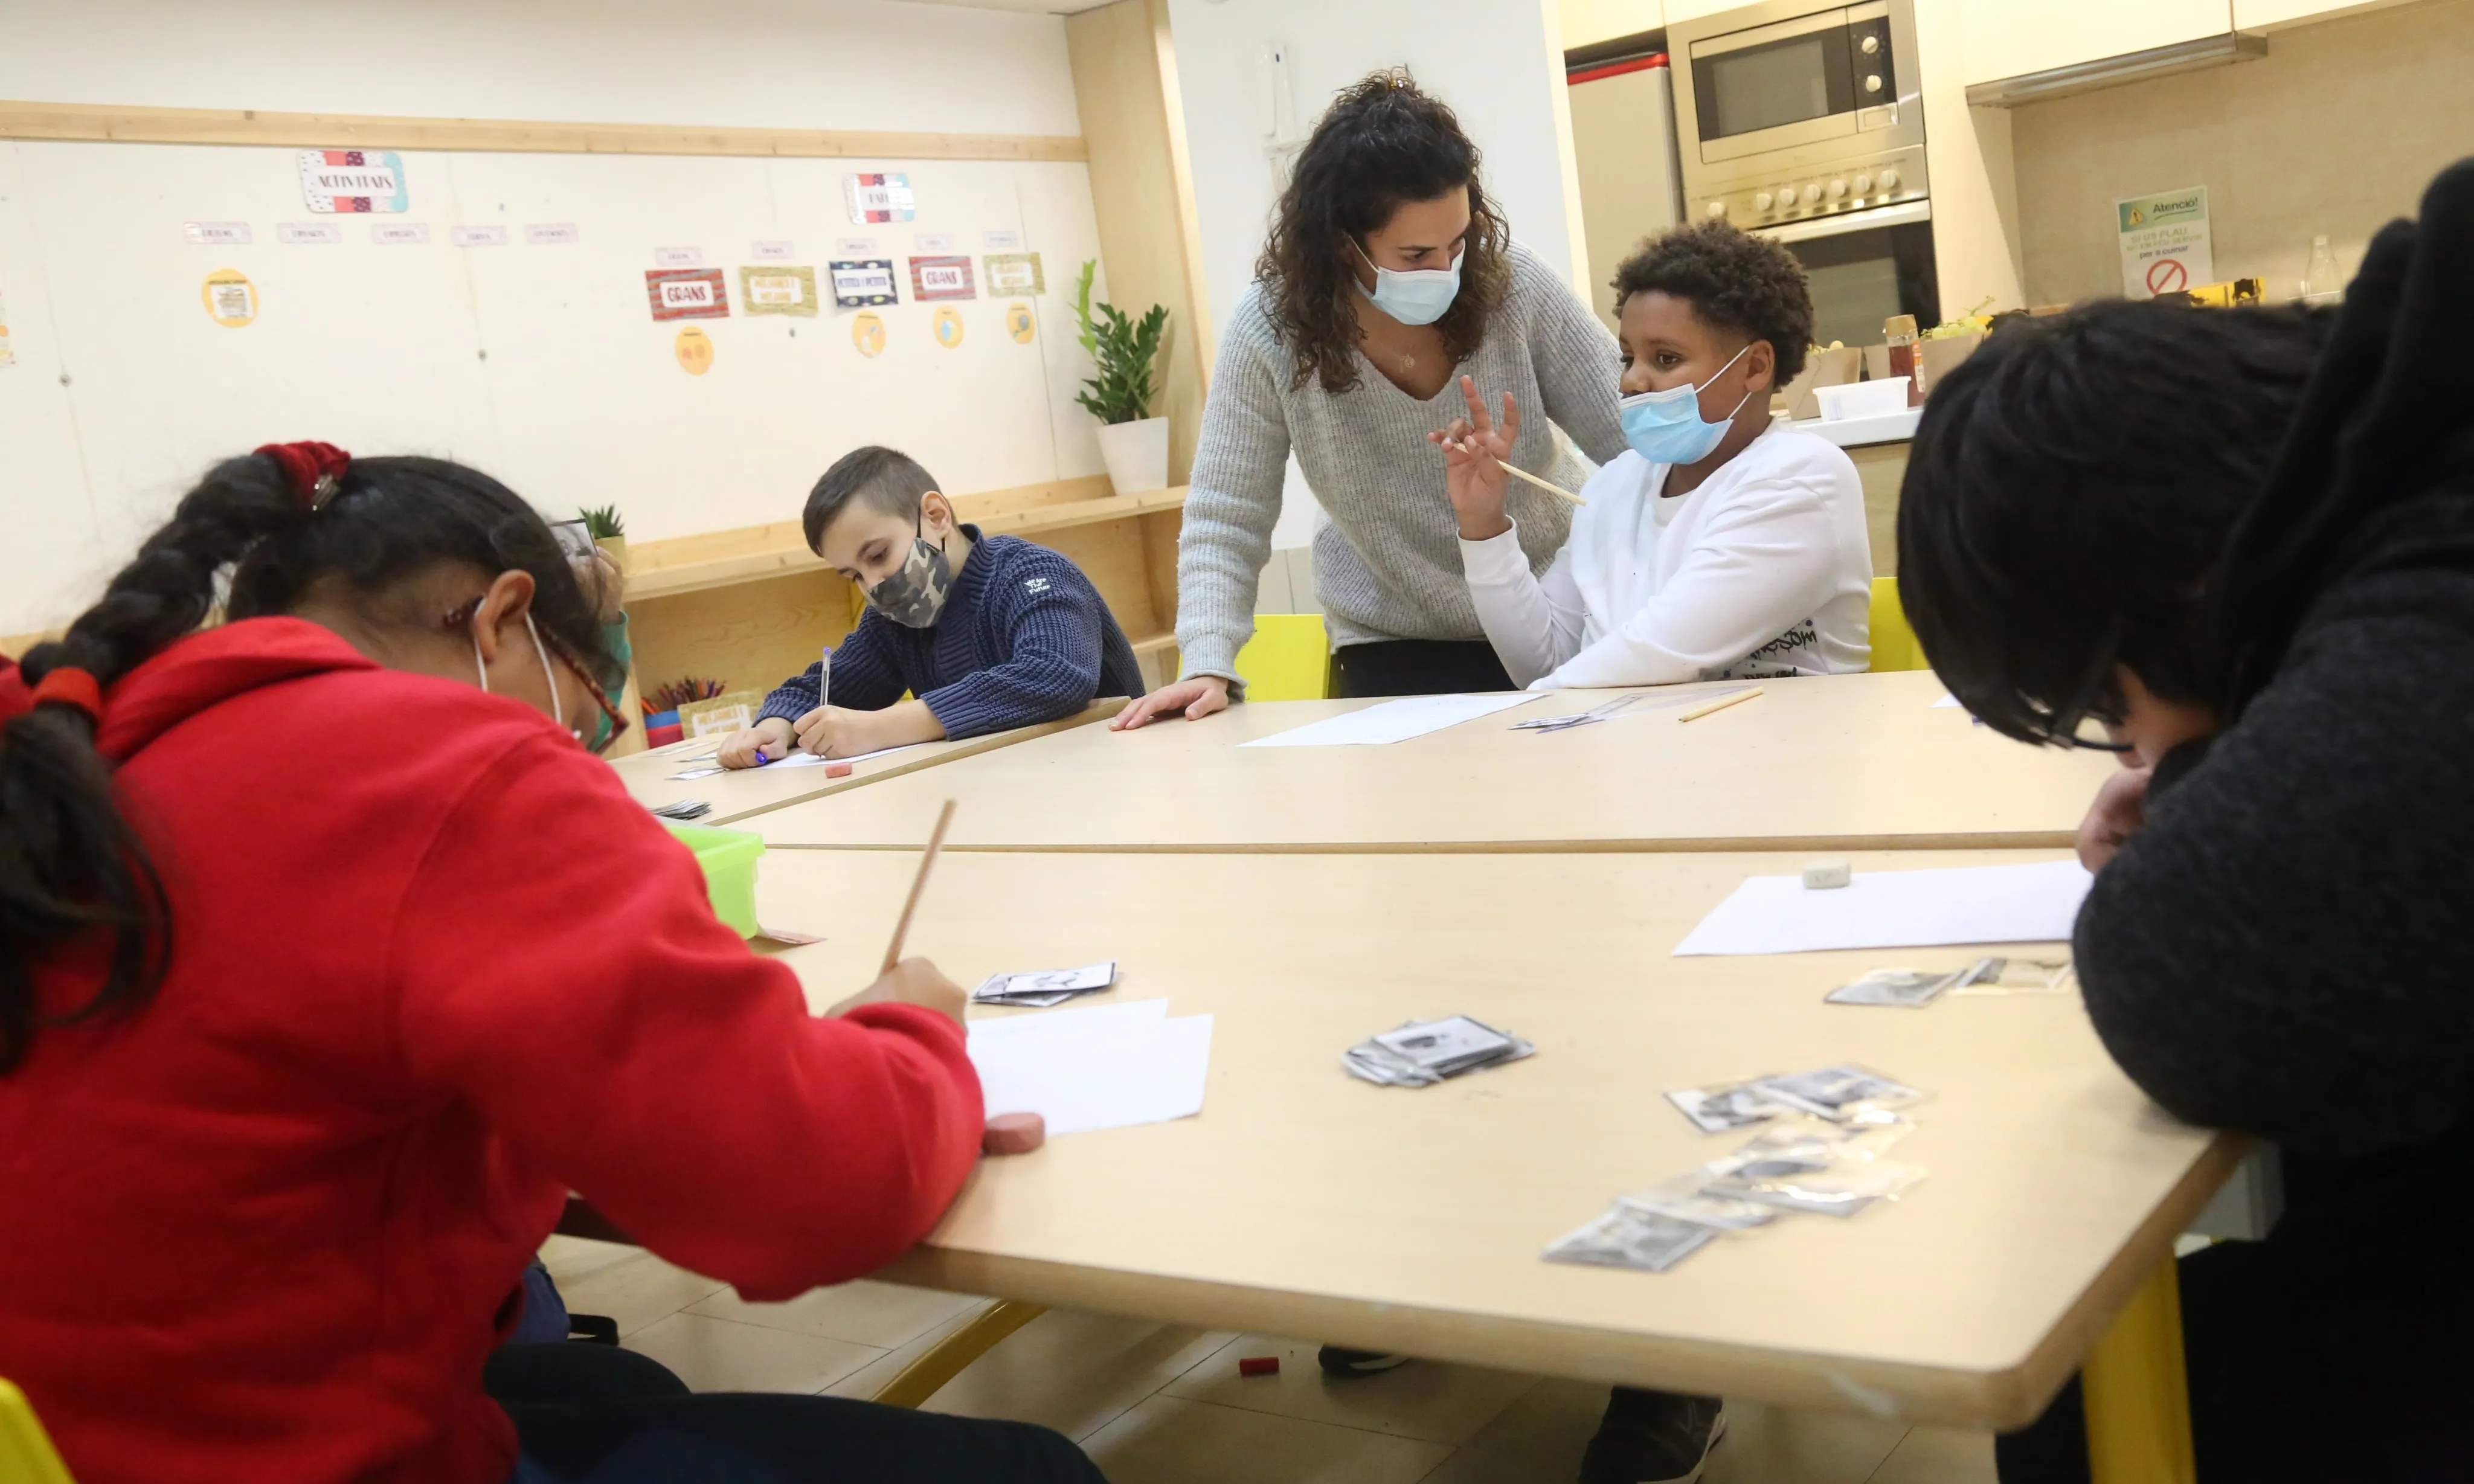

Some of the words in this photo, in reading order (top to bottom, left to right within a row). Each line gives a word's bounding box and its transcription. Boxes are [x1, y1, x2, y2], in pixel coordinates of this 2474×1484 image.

[2153, 197, 2199, 213] Atenció!
[925, 271, 959, 286] GRANS
[667, 285, 707, 302] GRANS
